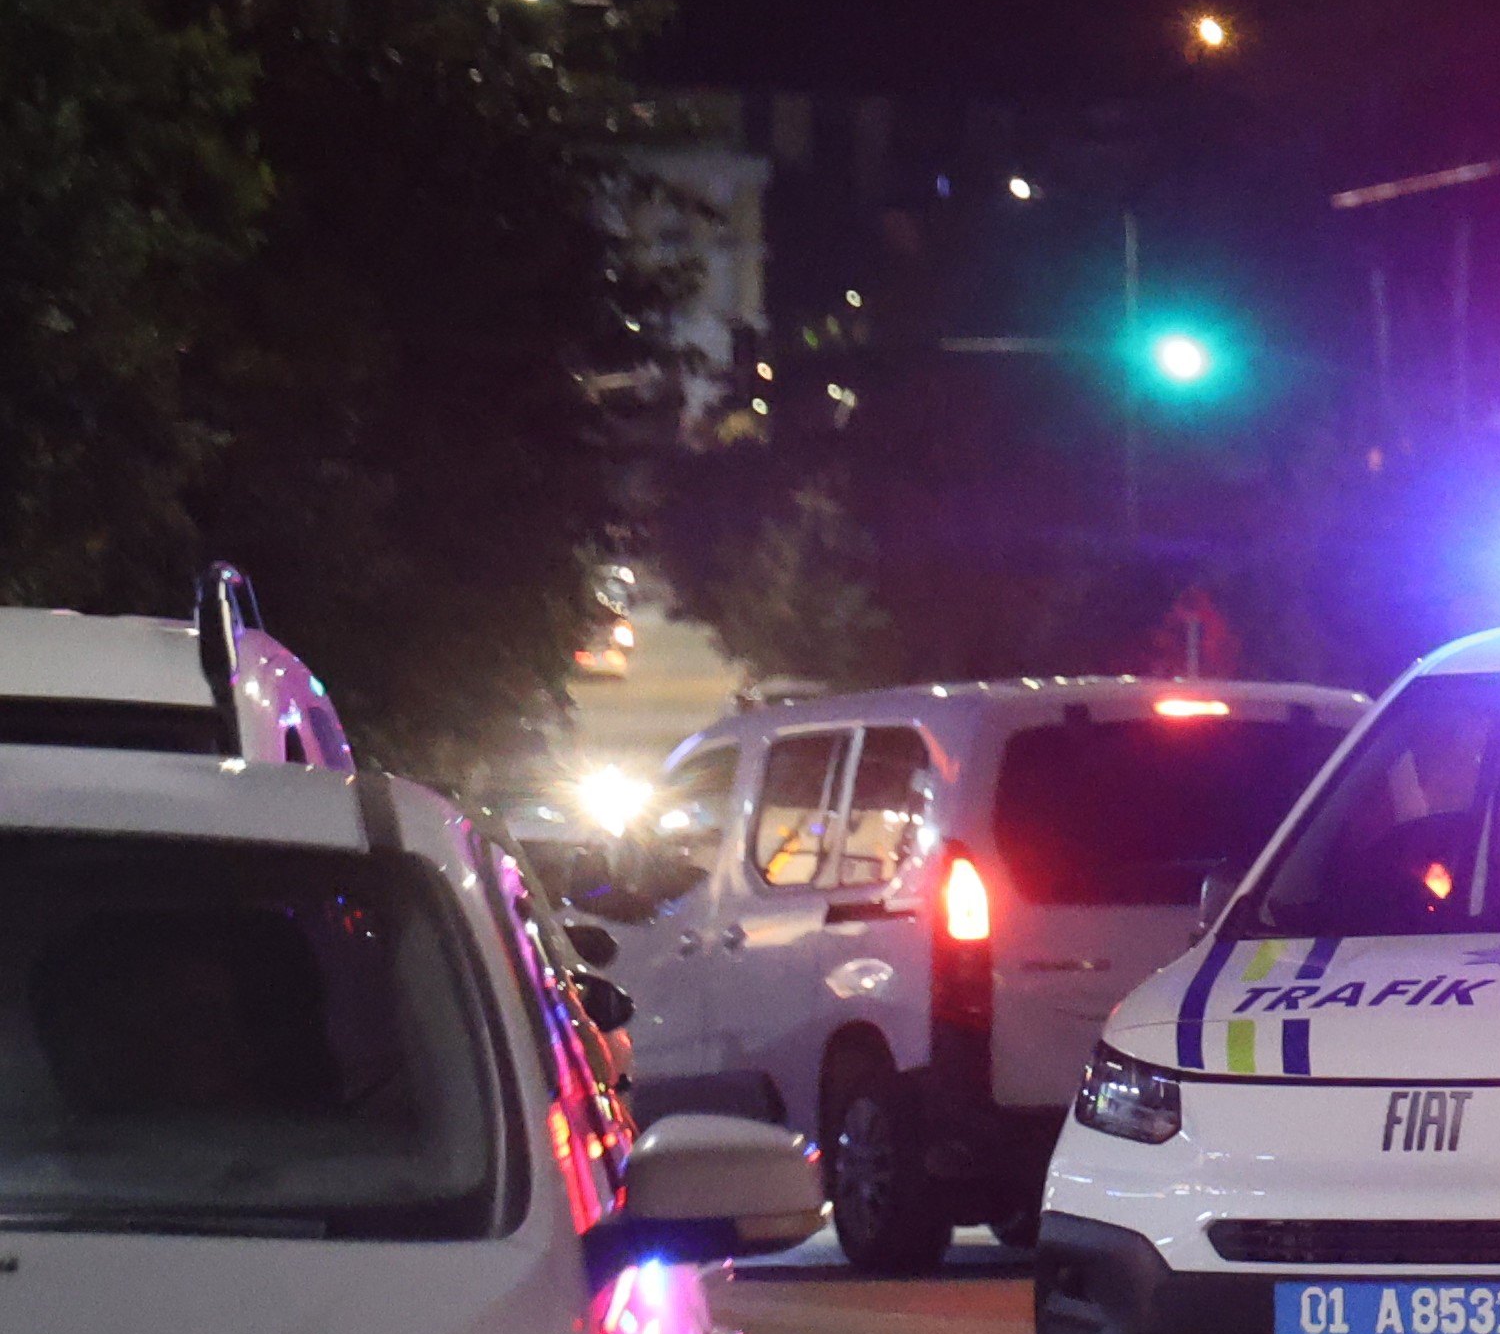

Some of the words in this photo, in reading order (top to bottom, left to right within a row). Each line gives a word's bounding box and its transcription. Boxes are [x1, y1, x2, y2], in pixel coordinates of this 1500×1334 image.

[1233, 974, 1494, 1013] TRAFİK
[1382, 1091, 1472, 1152] FIAT
[1301, 1286, 1349, 1334] 01
